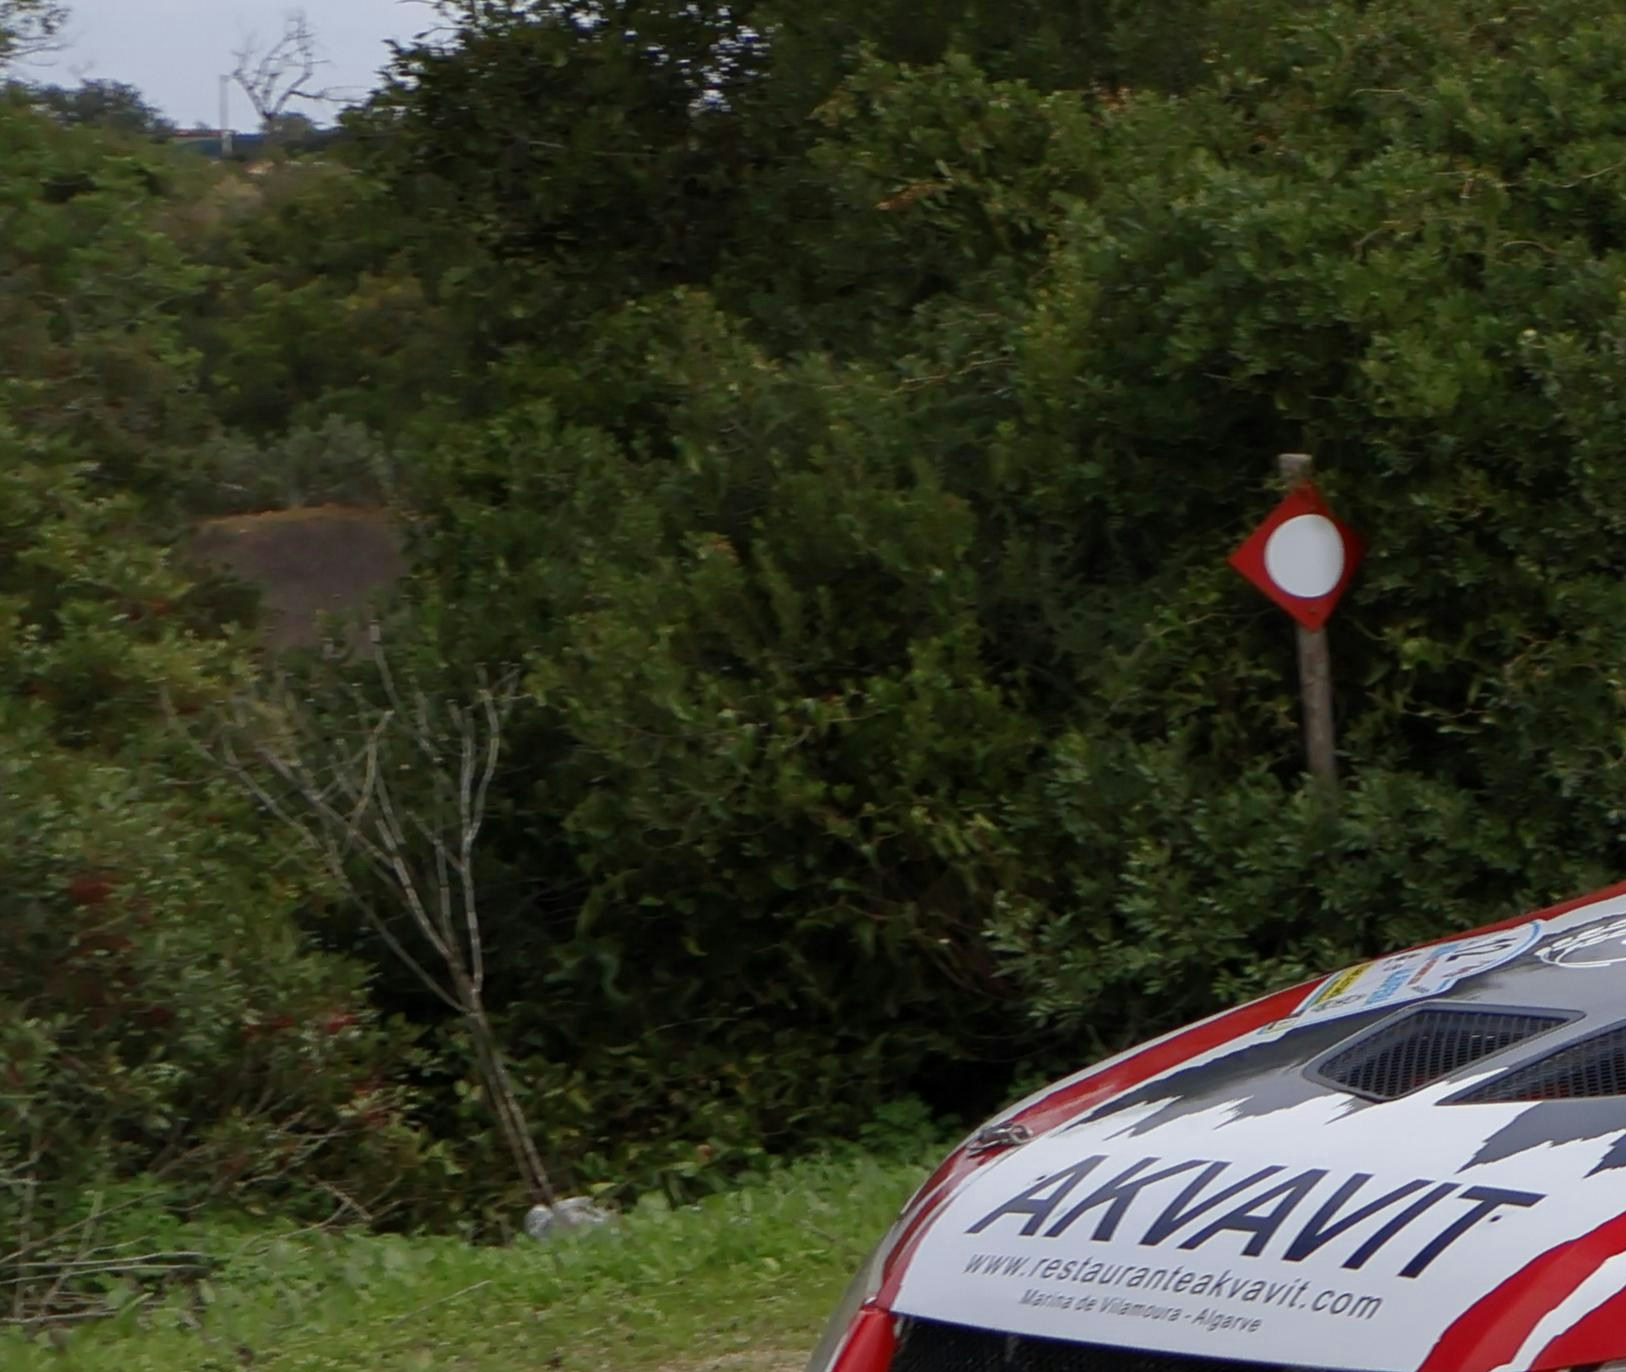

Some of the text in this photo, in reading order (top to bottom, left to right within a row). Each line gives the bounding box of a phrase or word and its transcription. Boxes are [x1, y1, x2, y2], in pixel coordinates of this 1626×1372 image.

[964, 1154, 1549, 1279] AKVAVIT
[963, 1250, 1384, 1321] www.restauranteakvavit.com
[1020, 1288, 1074, 1309] Marina
[1075, 1295, 1098, 1311] de
[1192, 1308, 1262, 1333] Algarve
